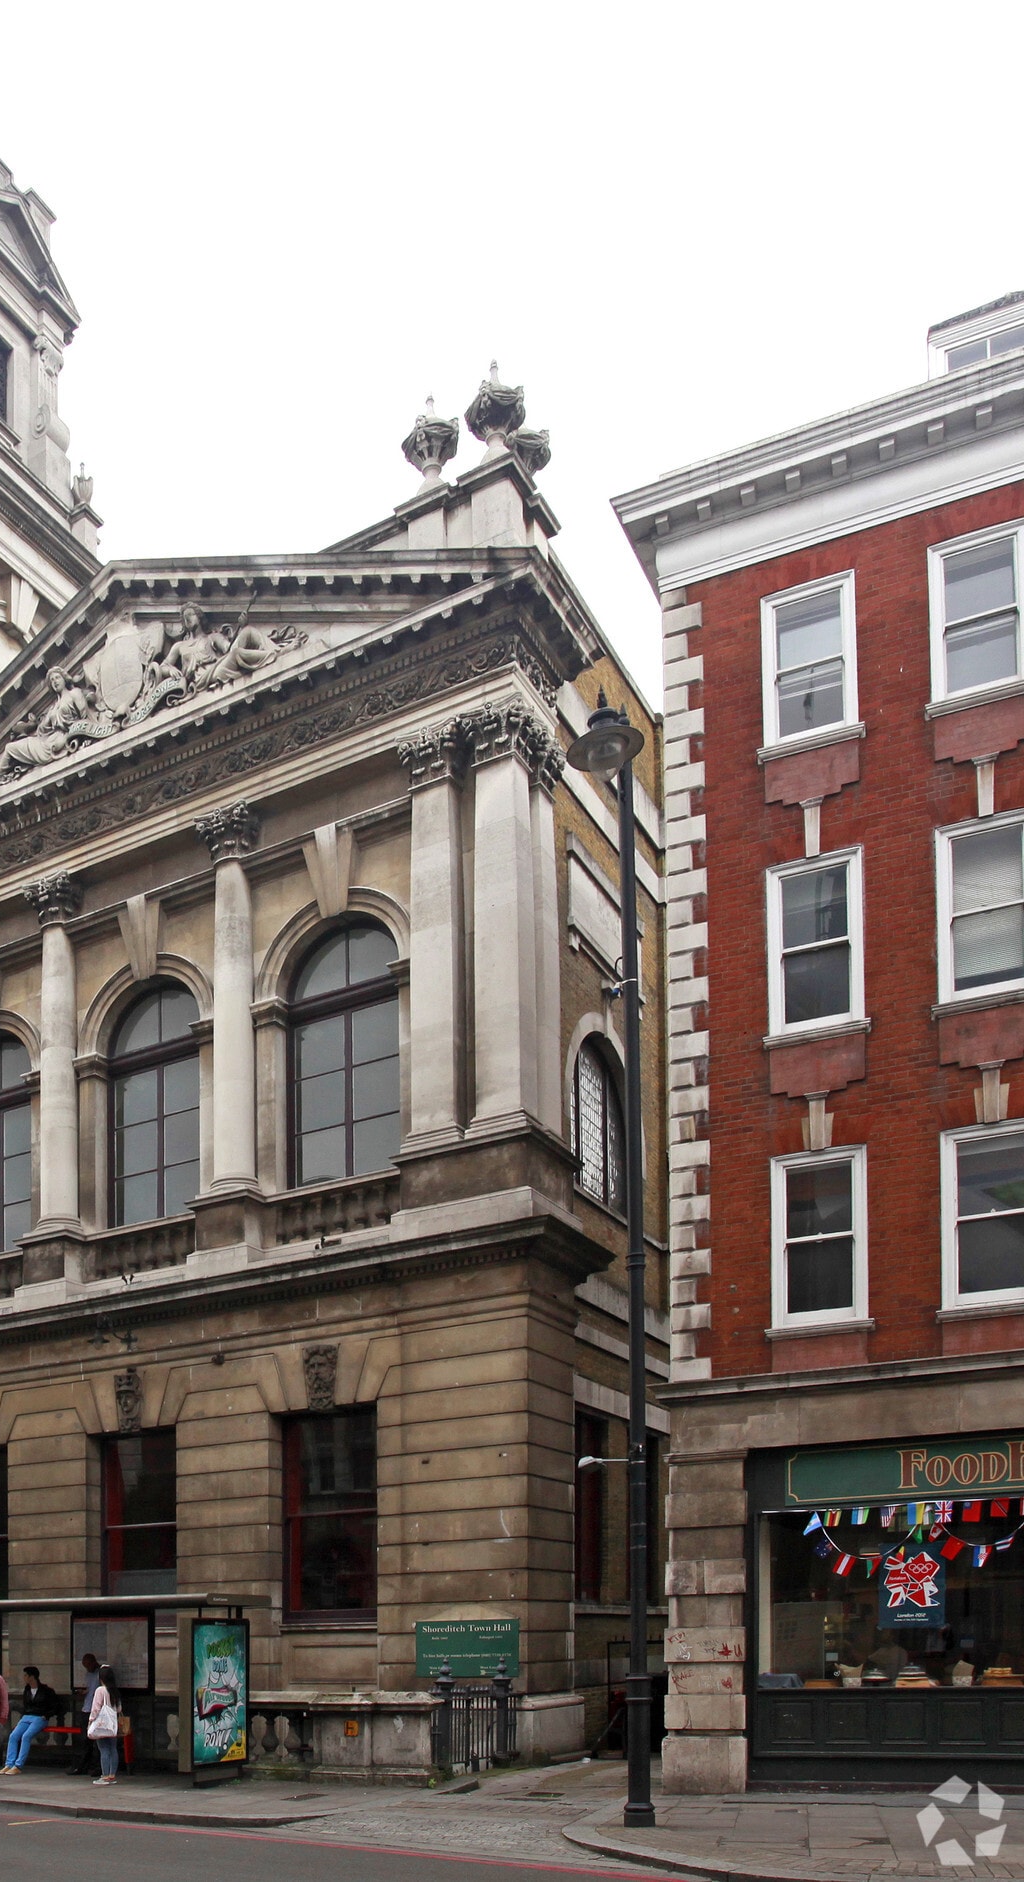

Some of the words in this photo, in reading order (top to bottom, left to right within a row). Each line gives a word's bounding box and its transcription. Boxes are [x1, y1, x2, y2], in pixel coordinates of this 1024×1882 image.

[69, 722, 88, 734] ORE
[422, 1624, 466, 1633] Shoreditch
[467, 1624, 491, 1632] Town
[493, 1623, 512, 1632] Hall
[203, 1729, 233, 1750] POW!
